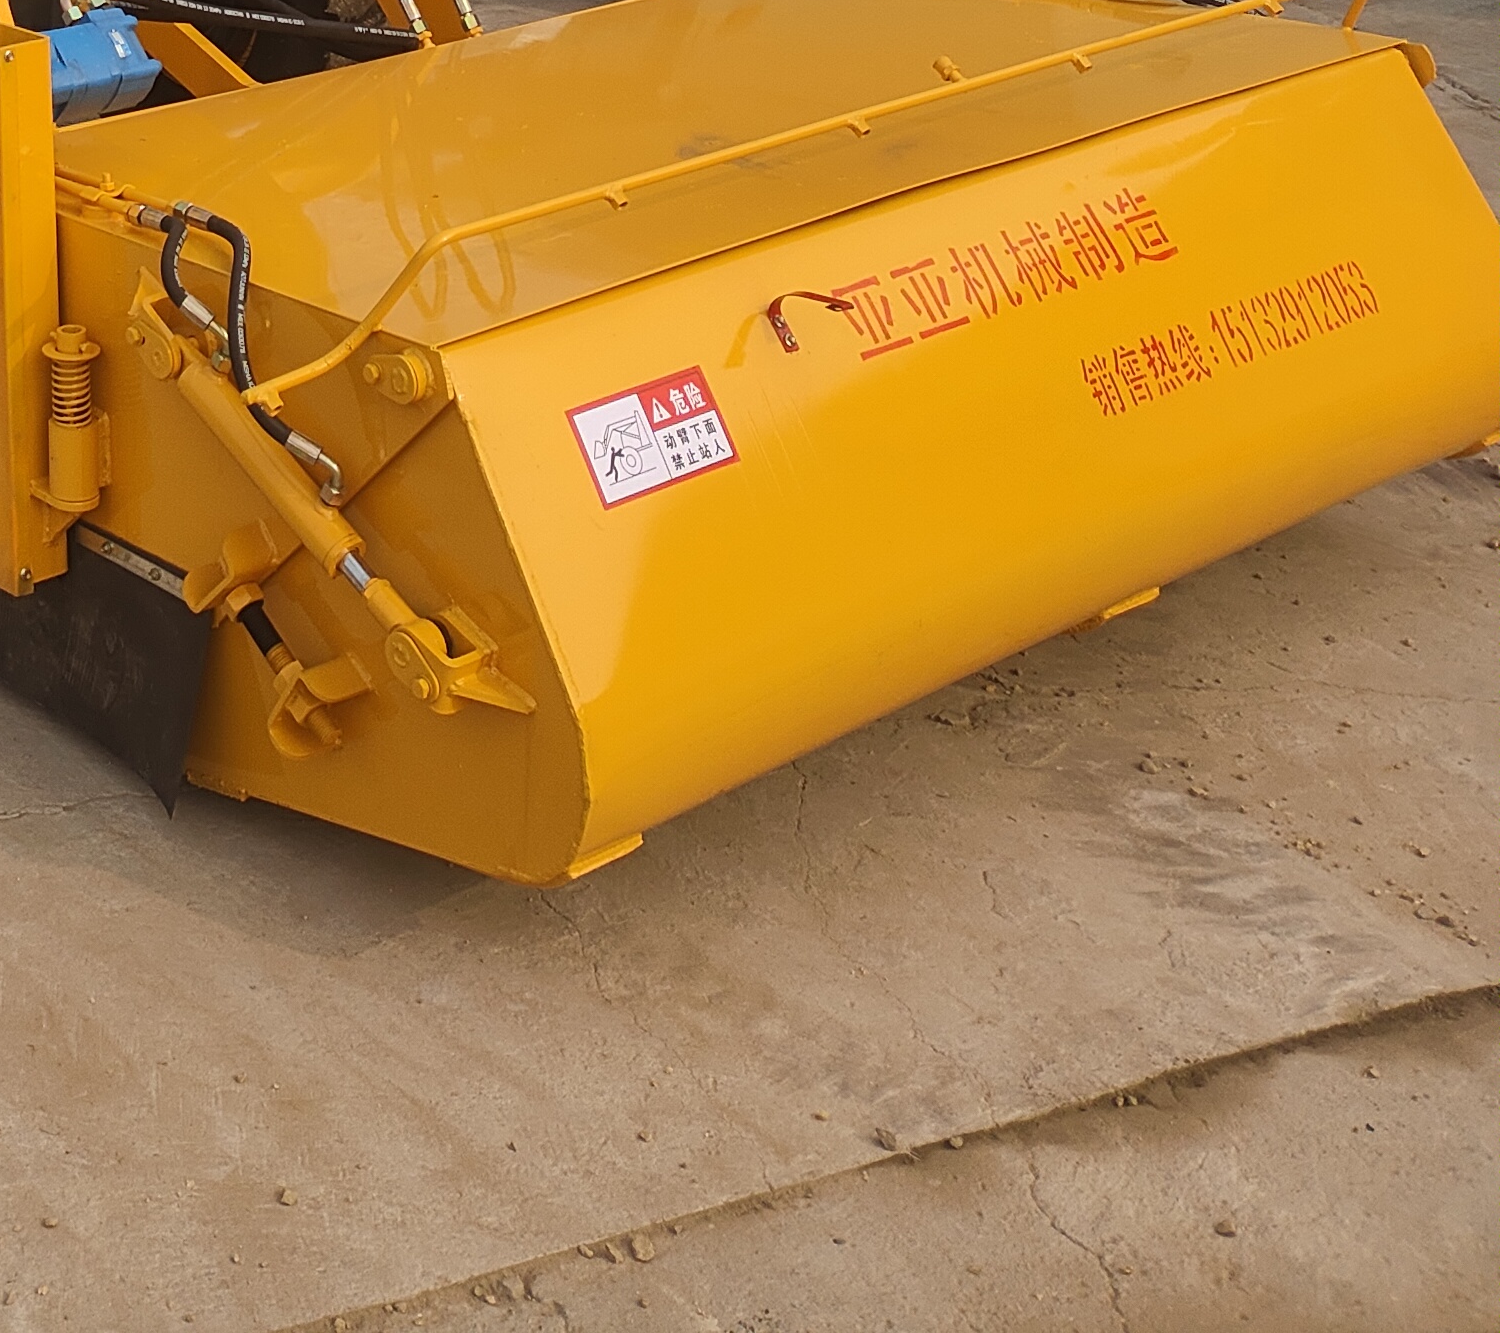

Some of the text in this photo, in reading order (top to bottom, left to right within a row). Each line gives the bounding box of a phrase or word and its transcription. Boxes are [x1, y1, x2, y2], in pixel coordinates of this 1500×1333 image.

[831, 187, 1179, 362] 亚亚机械制造
[668, 381, 707, 417] 危险
[663, 418, 717, 450] 动臂下面
[670, 438, 726, 471] 禁止站人
